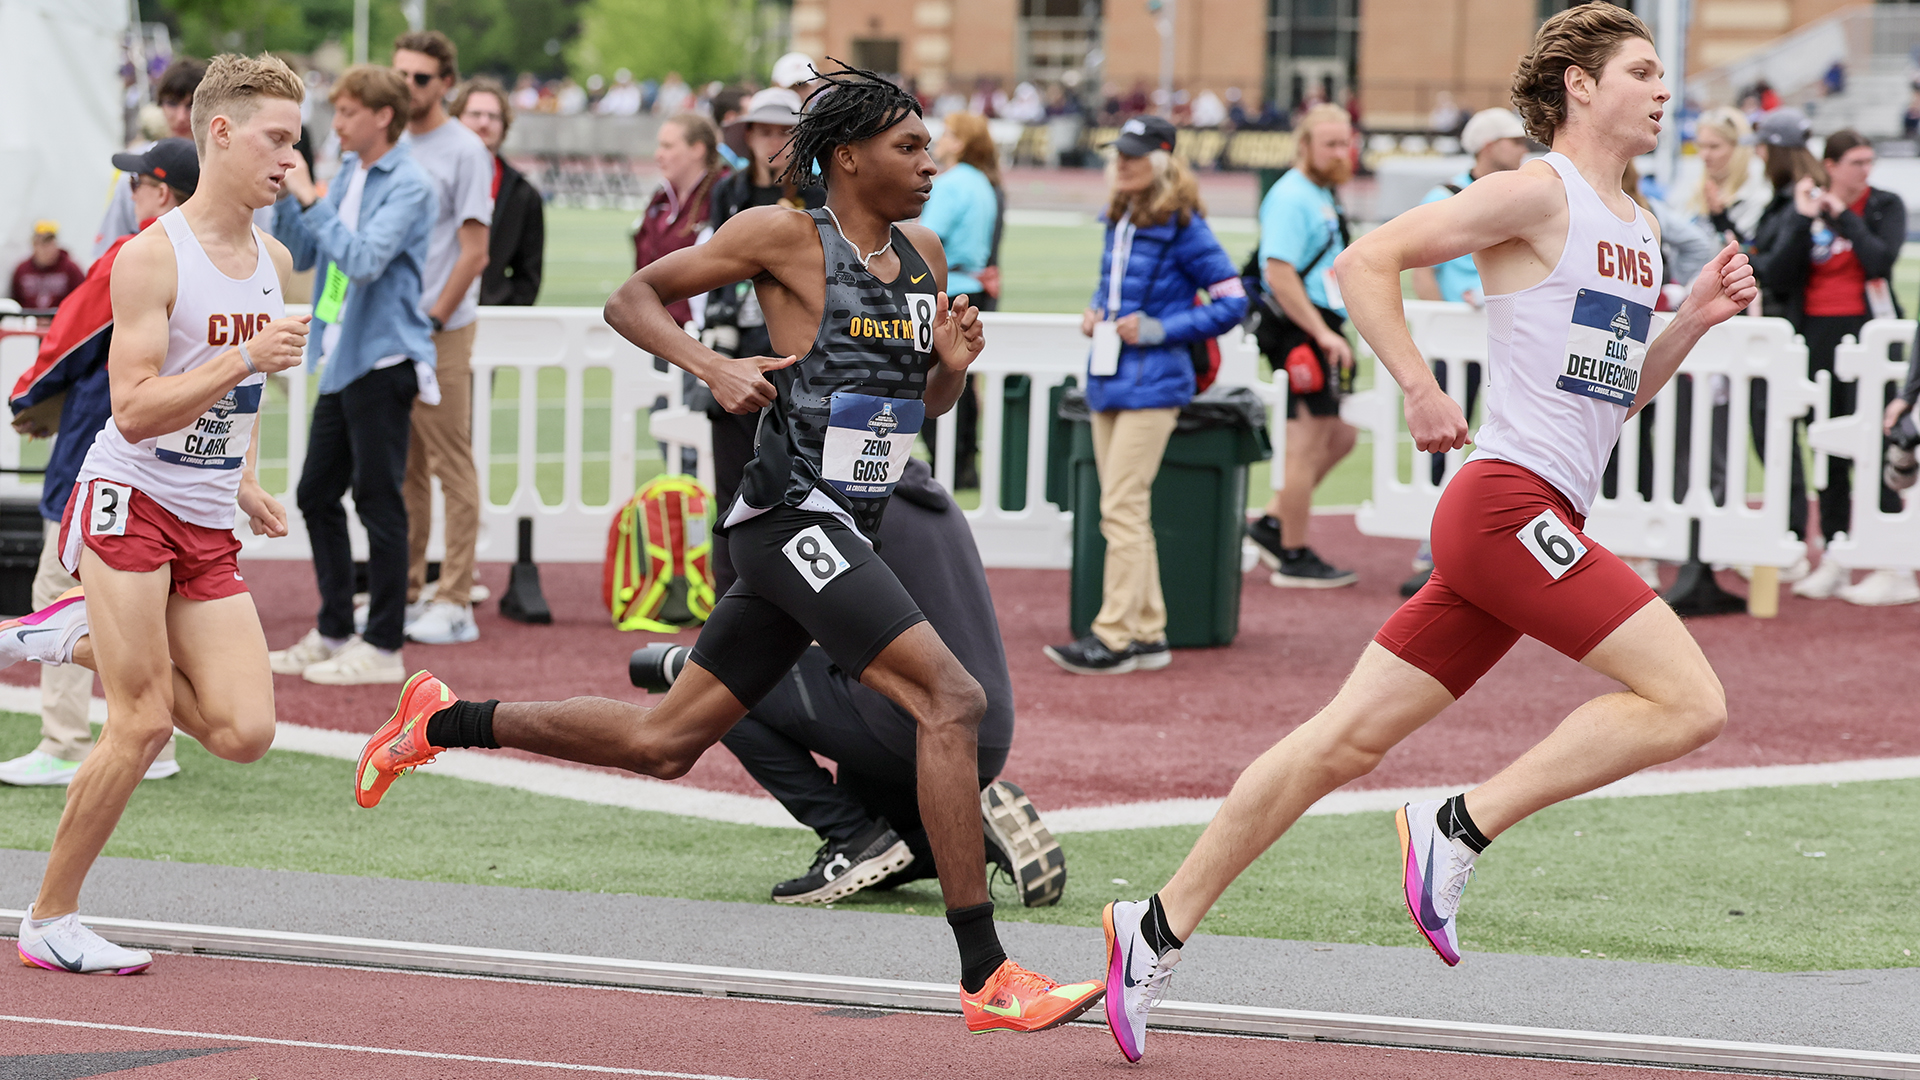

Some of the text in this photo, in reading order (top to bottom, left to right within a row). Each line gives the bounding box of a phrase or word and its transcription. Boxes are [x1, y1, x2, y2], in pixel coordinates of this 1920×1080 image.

[1597, 240, 1654, 288] CMS
[916, 299, 931, 350] 8
[1605, 340, 1628, 361] ELLIS
[1566, 354, 1638, 392] DELVECCHIO
[184, 434, 230, 456] CLARK
[195, 418, 233, 435] PIERCE
[862, 440, 891, 457] ZENO
[853, 460, 889, 482] GOSS
[97, 488, 119, 531] 3
[796, 536, 836, 580] 8
[1534, 520, 1575, 566] 6
